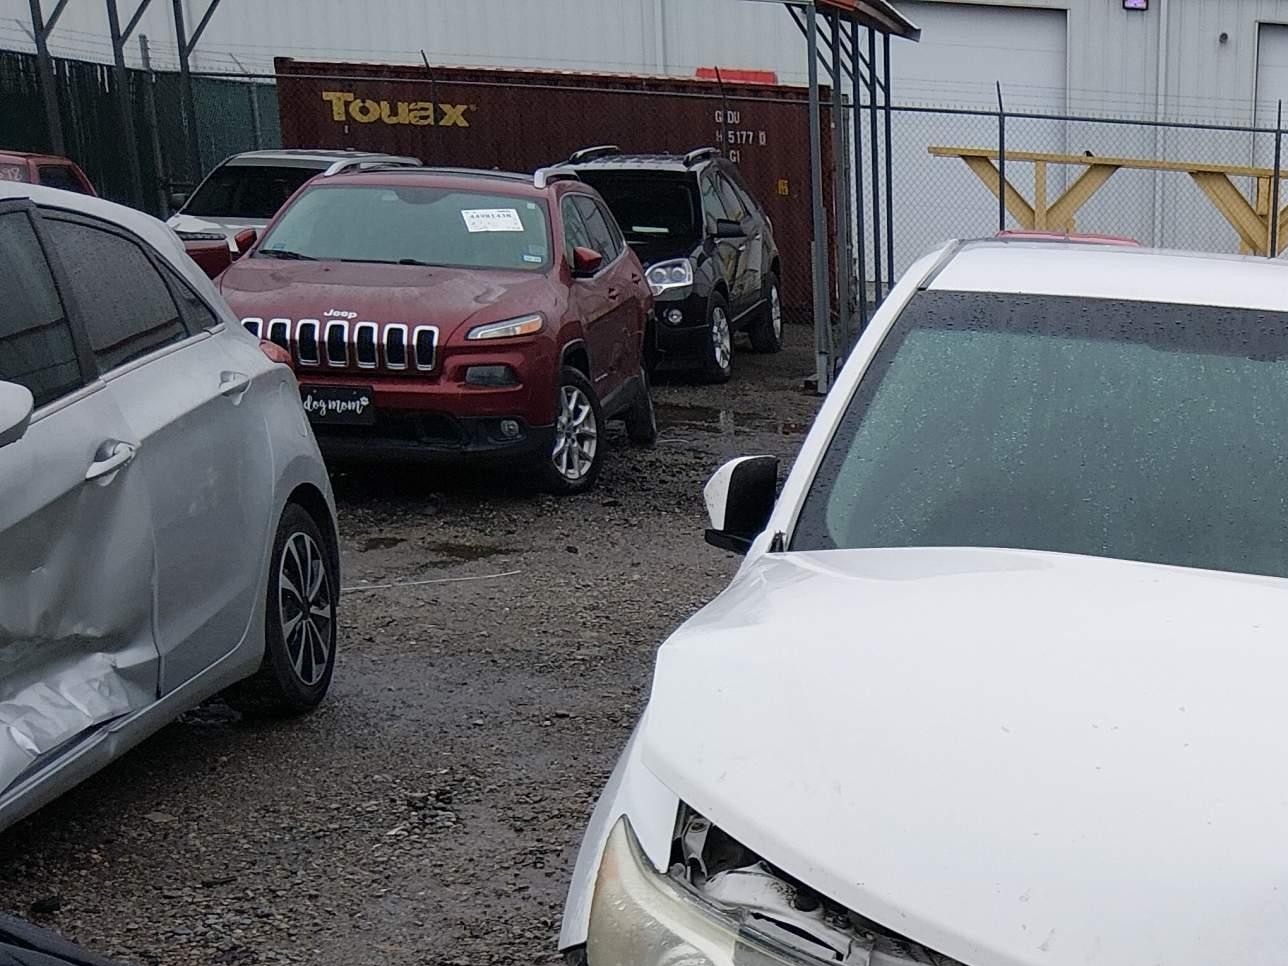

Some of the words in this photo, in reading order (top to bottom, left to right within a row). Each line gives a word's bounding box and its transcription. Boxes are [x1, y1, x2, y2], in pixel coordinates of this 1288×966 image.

[322, 91, 470, 127] Touax
[715, 111, 740, 123] GDU
[323, 309, 358, 319] Jeep
